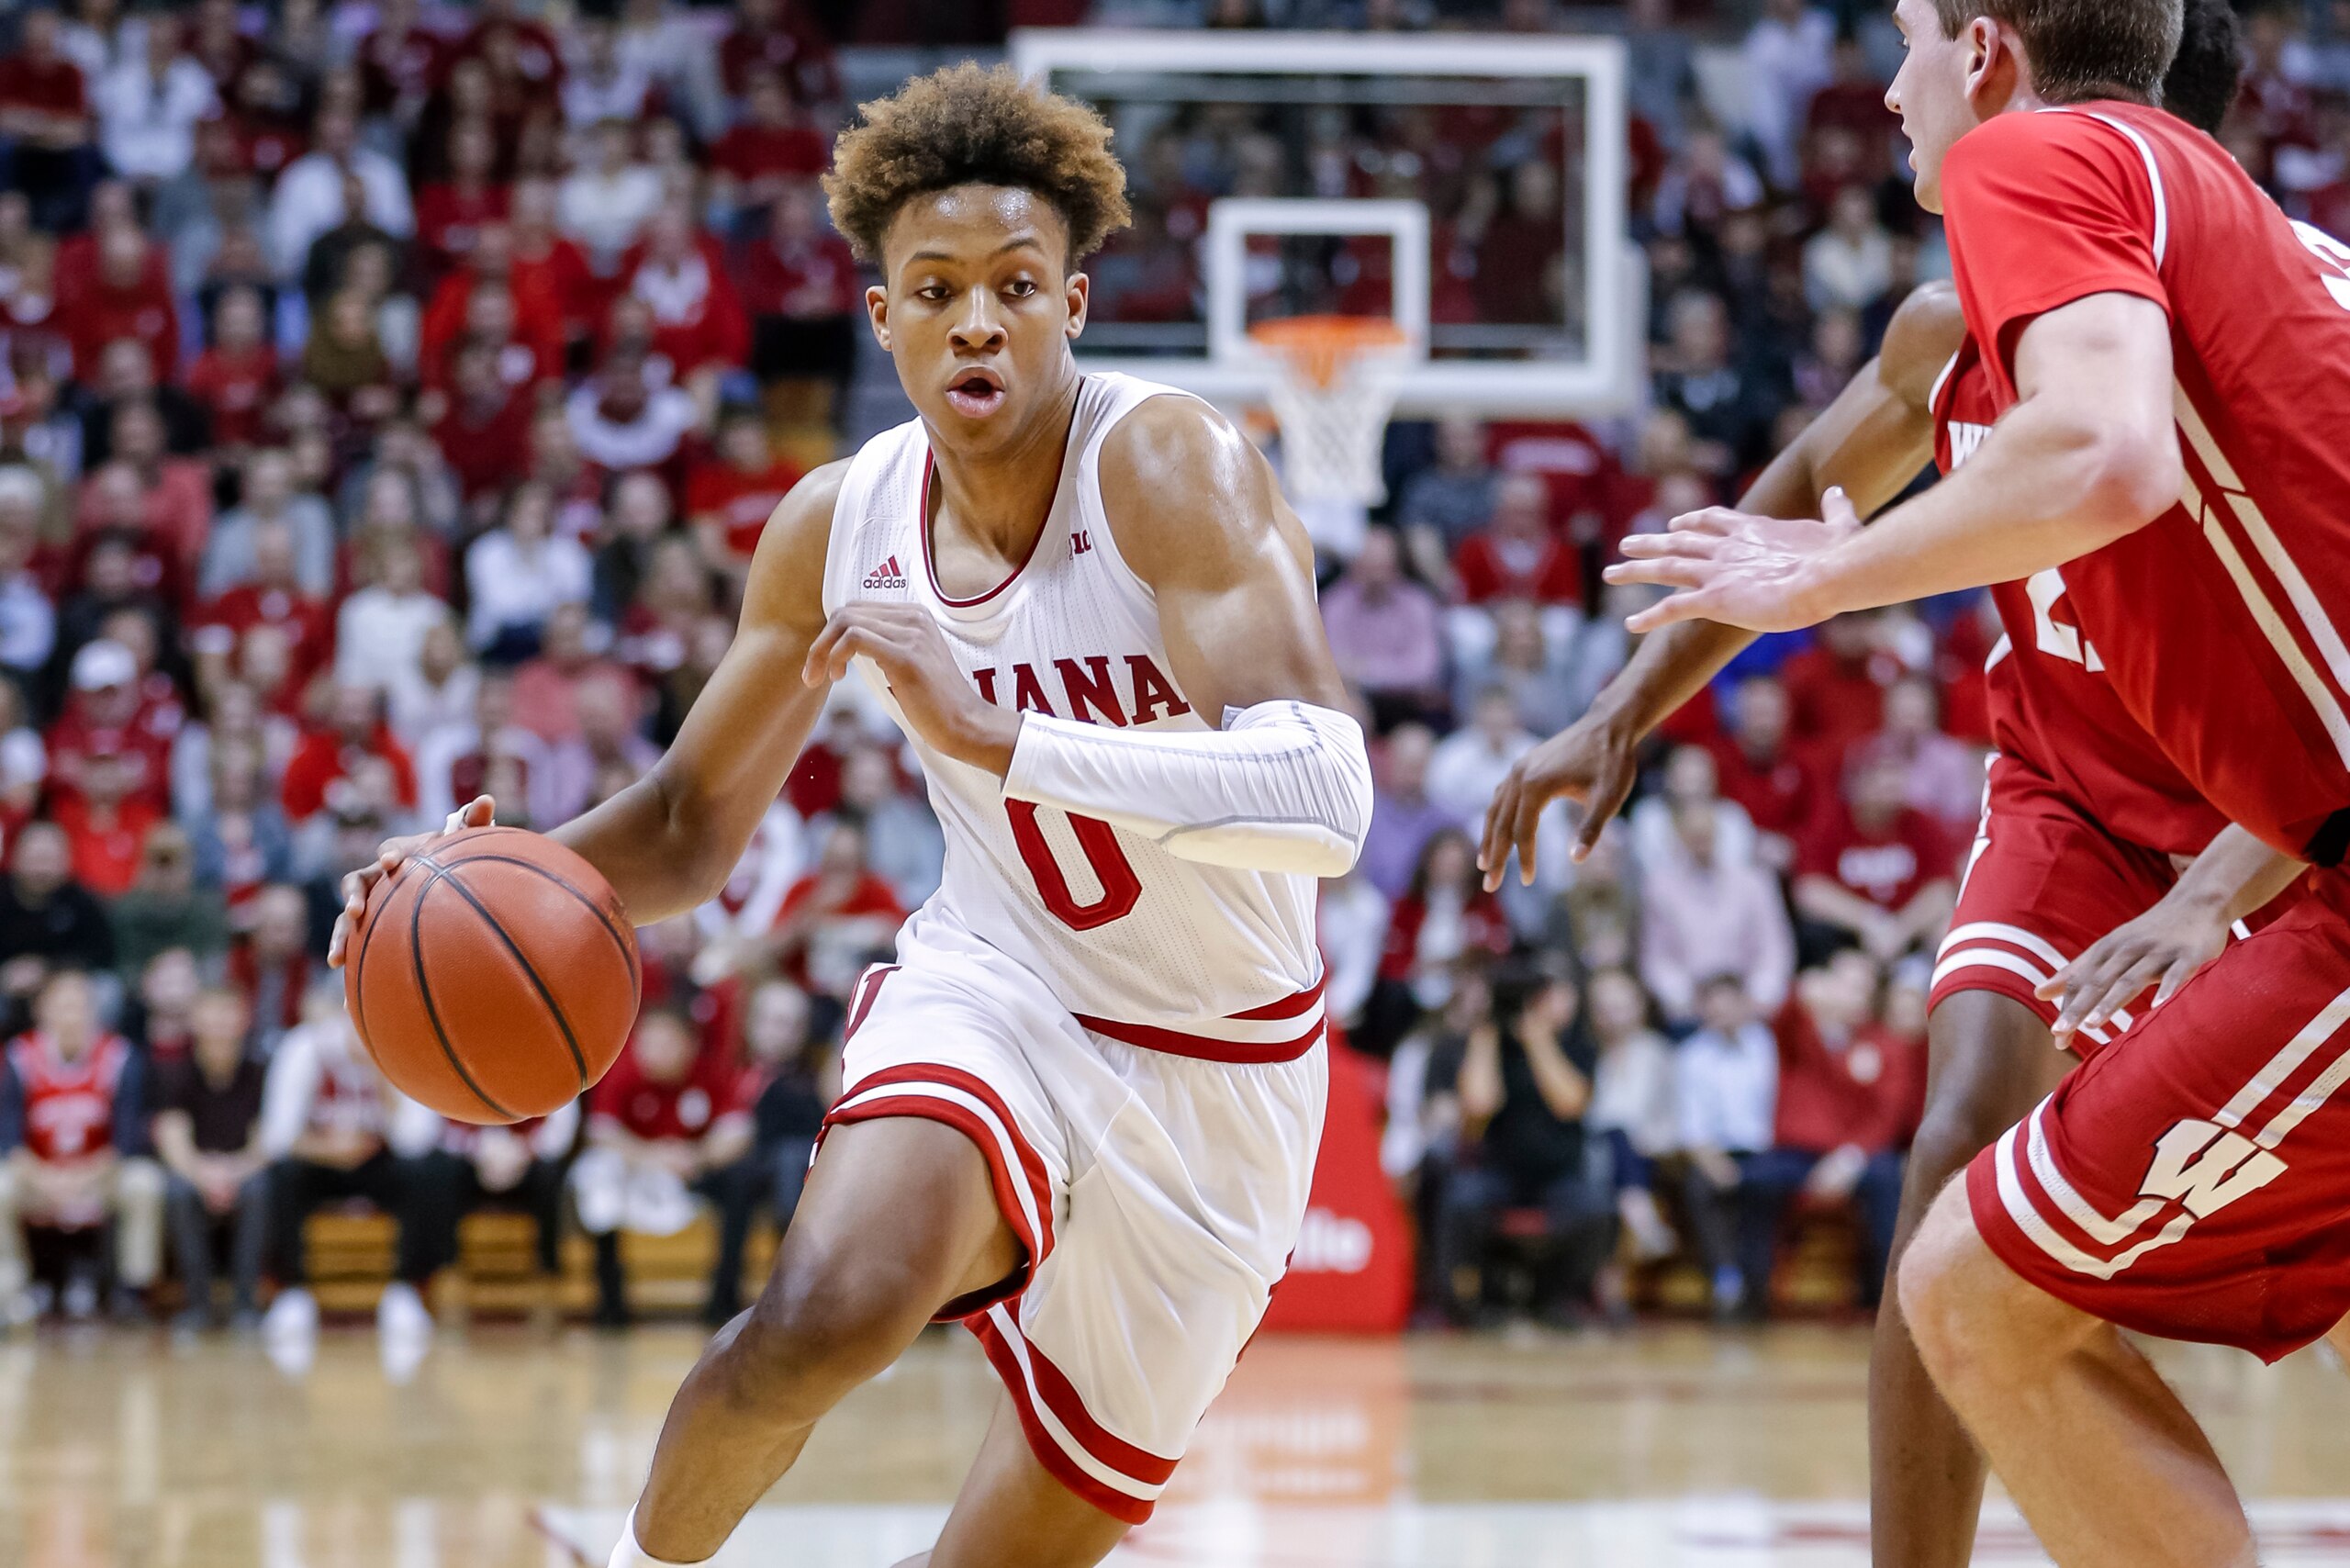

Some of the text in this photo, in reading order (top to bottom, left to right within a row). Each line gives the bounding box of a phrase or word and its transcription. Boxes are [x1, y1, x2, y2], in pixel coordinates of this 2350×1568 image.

[863, 577, 907, 588] adidas
[972, 655, 1192, 728] IANA
[1003, 797, 1143, 932] 0
[2136, 1118, 2289, 1220] W
